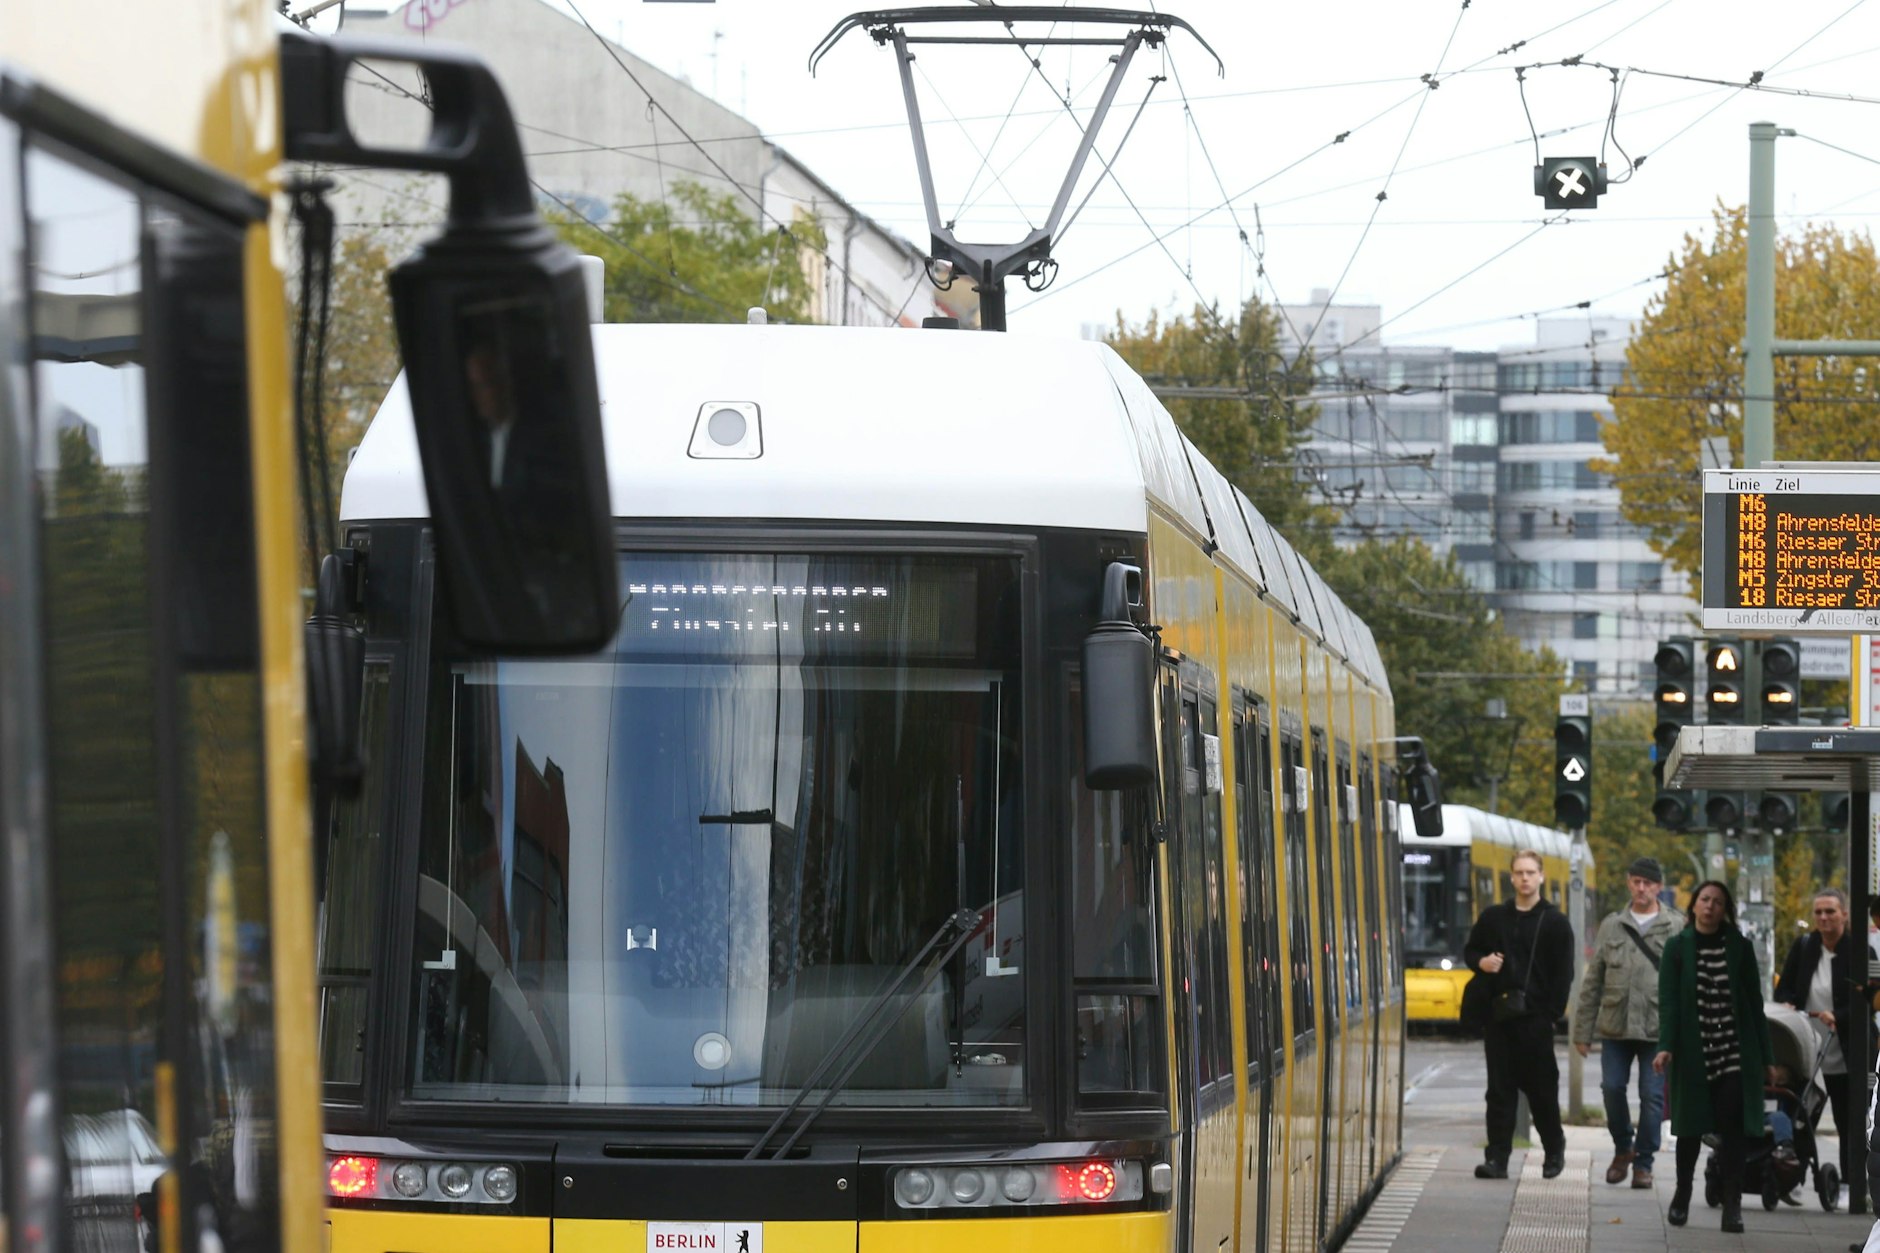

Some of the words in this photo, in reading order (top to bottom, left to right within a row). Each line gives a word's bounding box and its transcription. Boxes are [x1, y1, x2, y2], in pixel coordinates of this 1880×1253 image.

[1728, 478, 1761, 491] Linie
[1775, 478, 1800, 491] Ziel
[1739, 493, 1767, 512] M6
[1739, 512, 1767, 531] M8
[1739, 531, 1766, 550] M6
[1777, 532, 1847, 550] Riesaer
[1738, 550, 1766, 569] M8
[1738, 568, 1766, 588] M5
[1776, 569, 1854, 590] Zingster
[1740, 588, 1766, 607] 18
[1776, 588, 1847, 607] Riesaer
[1817, 612, 1880, 626] Allee/Pet
[655, 1234, 716, 1248] BERLIN
